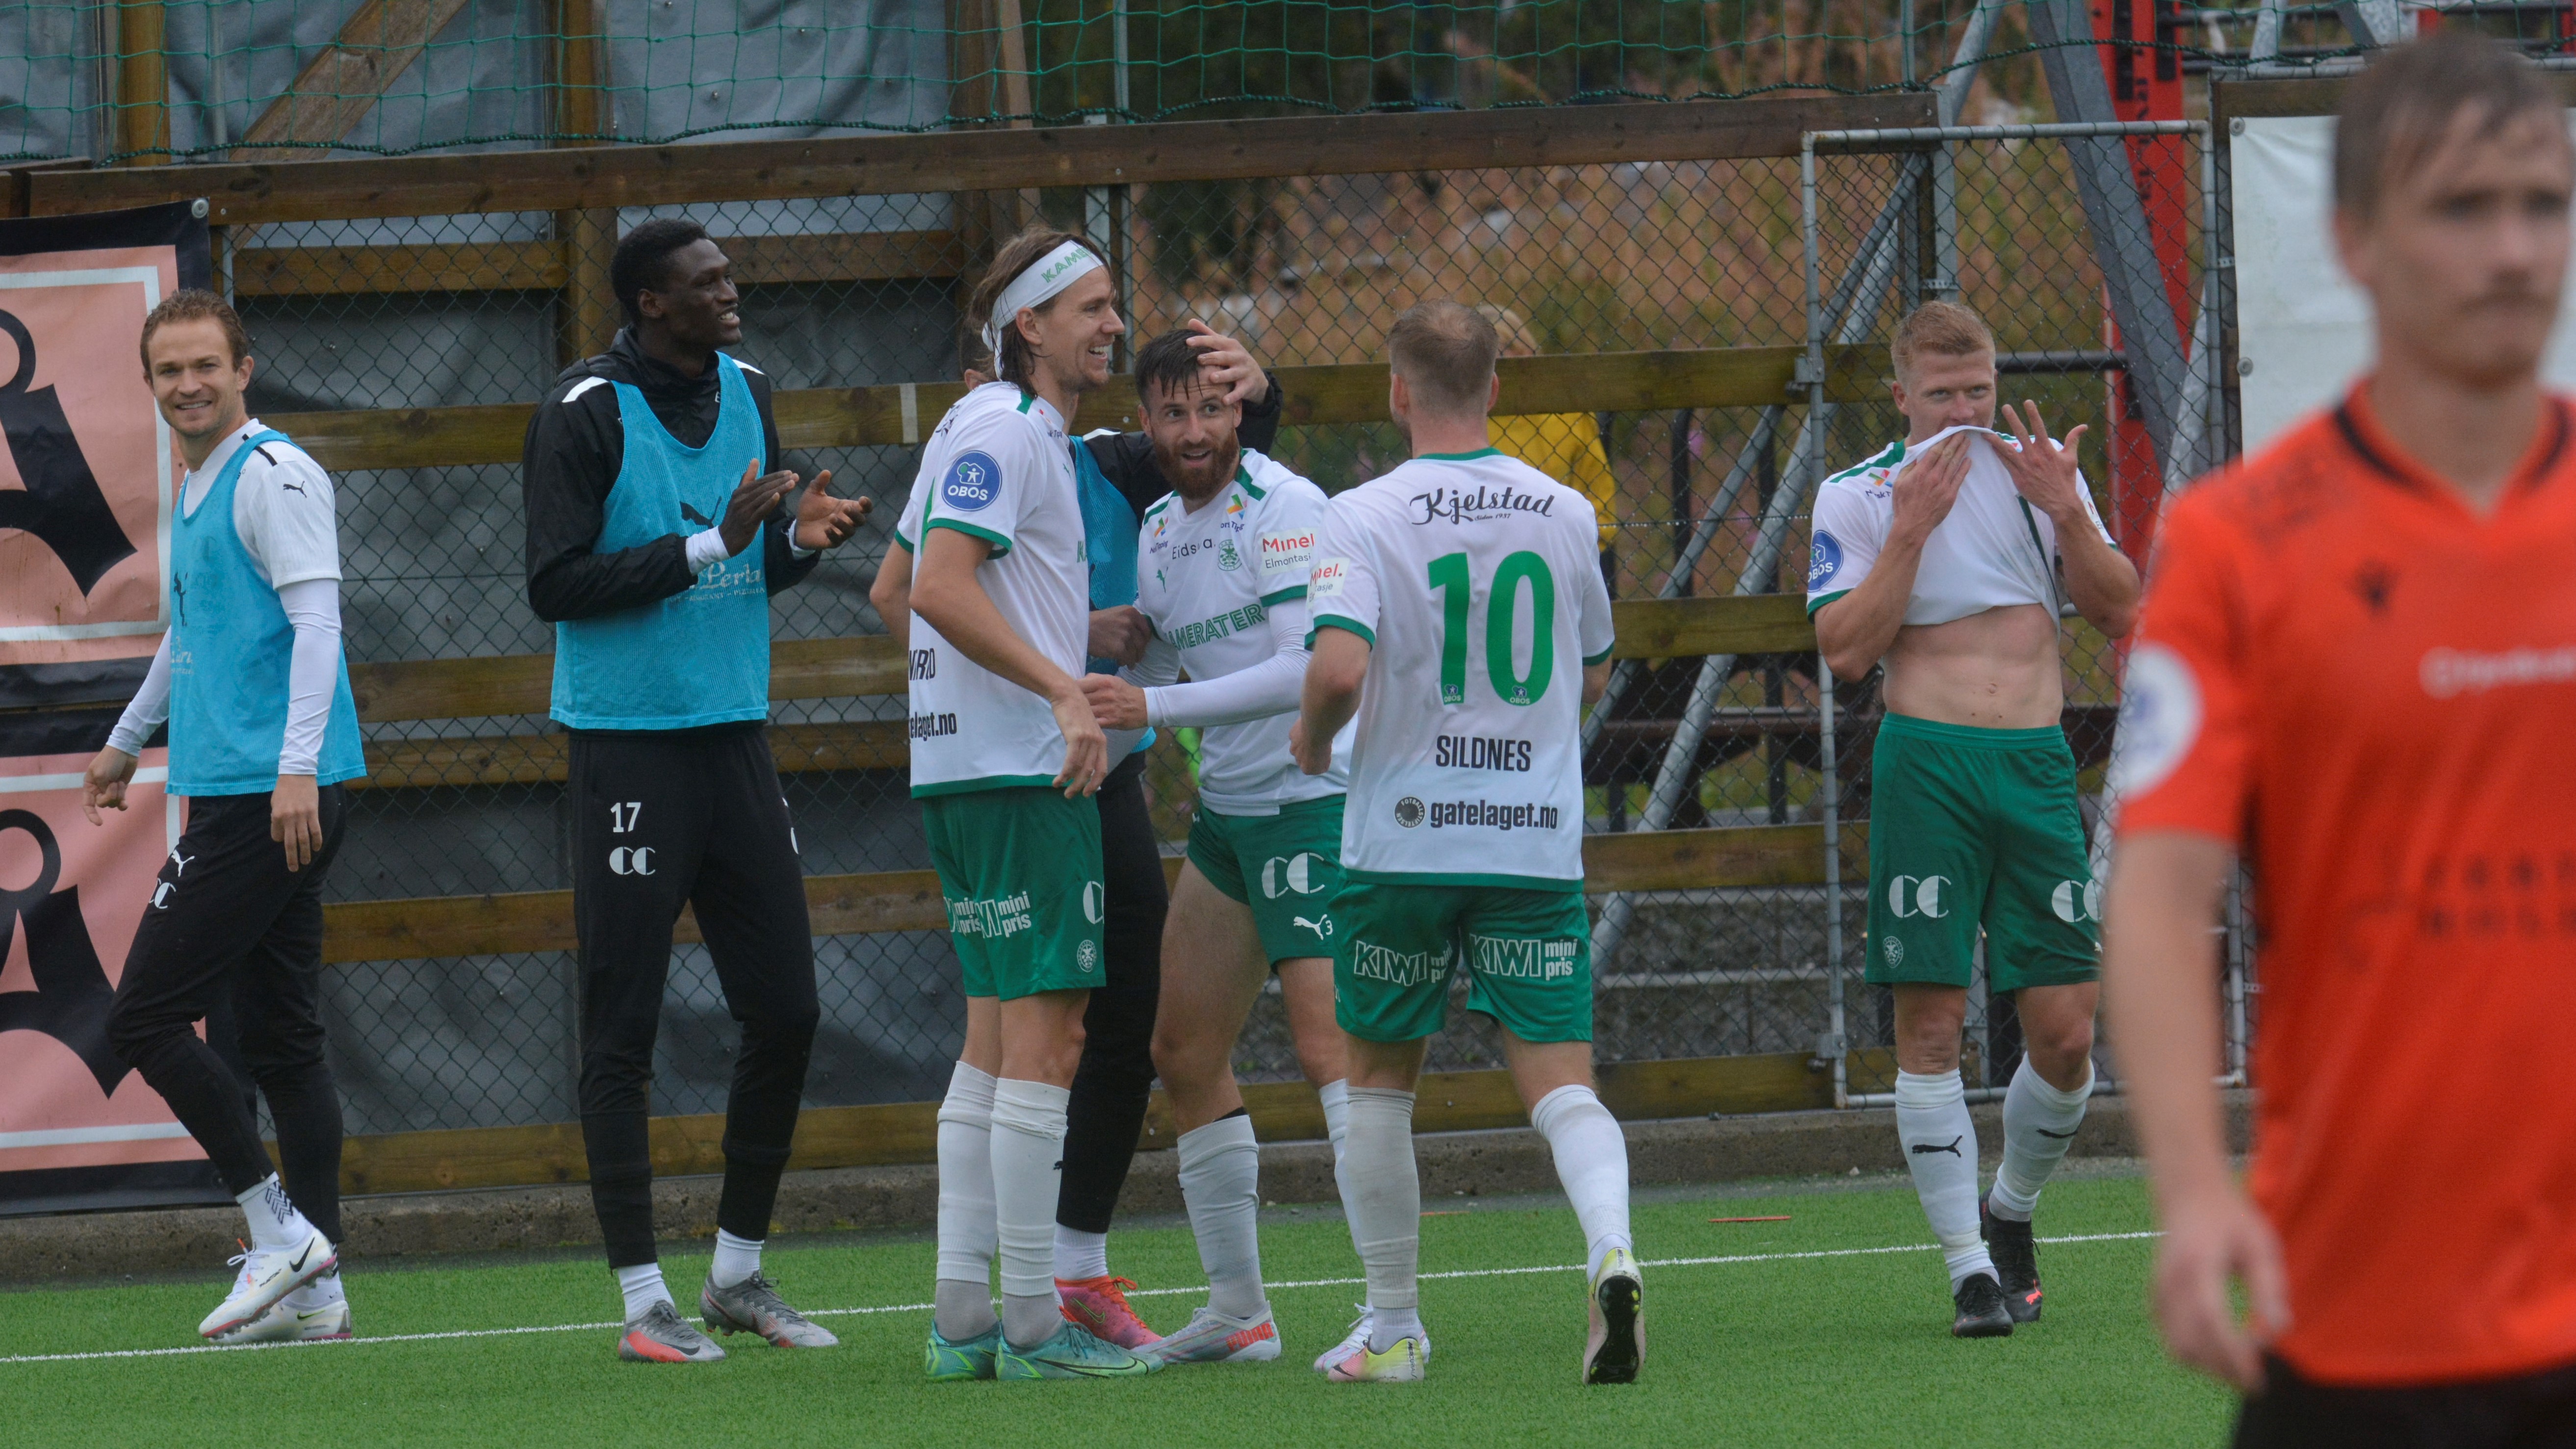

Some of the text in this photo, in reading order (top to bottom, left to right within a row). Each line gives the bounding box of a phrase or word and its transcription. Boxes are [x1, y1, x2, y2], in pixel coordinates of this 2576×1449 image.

[948, 485, 989, 501] OBOS
[1410, 486, 1555, 525] Kjelstad
[1165, 603, 1265, 651] AMERATER
[1427, 550, 1555, 706] 10
[1443, 695, 1530, 705] OBOS OBOS
[1436, 735, 1532, 772] SILDNES
[610, 802, 642, 833] 17
[1430, 799, 1558, 831] gatelaget.no
[609, 846, 656, 876] CC
[998, 891, 1031, 916] mini
[1002, 913, 1032, 938] pris
[1325, 920, 1333, 935] 3
[1354, 940, 1427, 986] KIWI
[1470, 933, 1542, 977] KIWI
[1545, 939, 1578, 958] mini
[1546, 957, 1573, 981] pris
